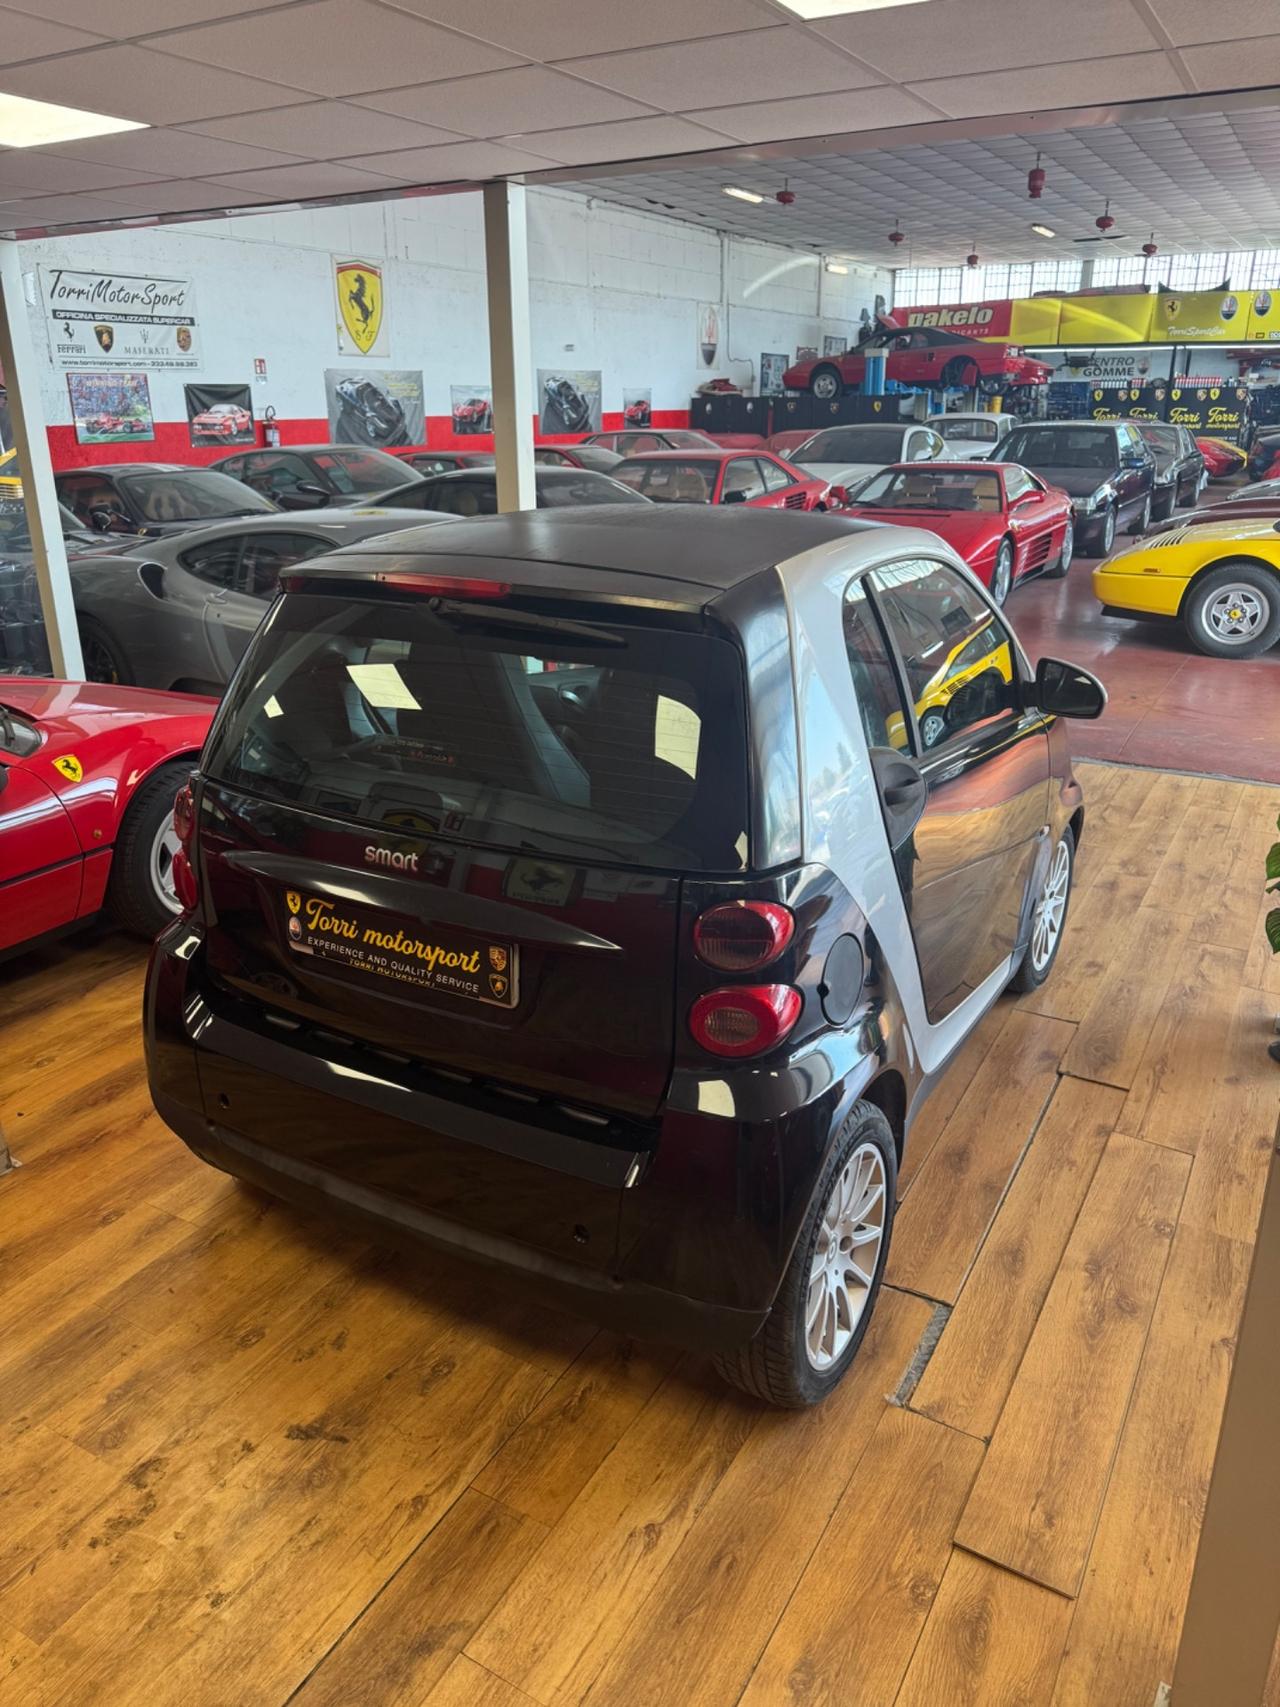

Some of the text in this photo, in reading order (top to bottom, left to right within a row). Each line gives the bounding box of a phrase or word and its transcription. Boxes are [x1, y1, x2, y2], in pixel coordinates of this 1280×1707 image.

[50, 269, 187, 313] TorriMotorSport
[56, 311, 191, 325] OFFICINA SPECIALIZZATA SUPERCAR
[908, 306, 994, 327] pakelo
[124, 346, 170, 355] MASERATI
[1083, 366, 1135, 377] GOMME
[1093, 407, 1122, 421] Torri
[1169, 407, 1200, 423] Torri
[1208, 406, 1239, 423] Torri
[365, 845, 419, 872] smart
[305, 898, 481, 974] Torri motorsport
[307, 936, 480, 993] EXPERIENCE AND QUALITY SERVICE
